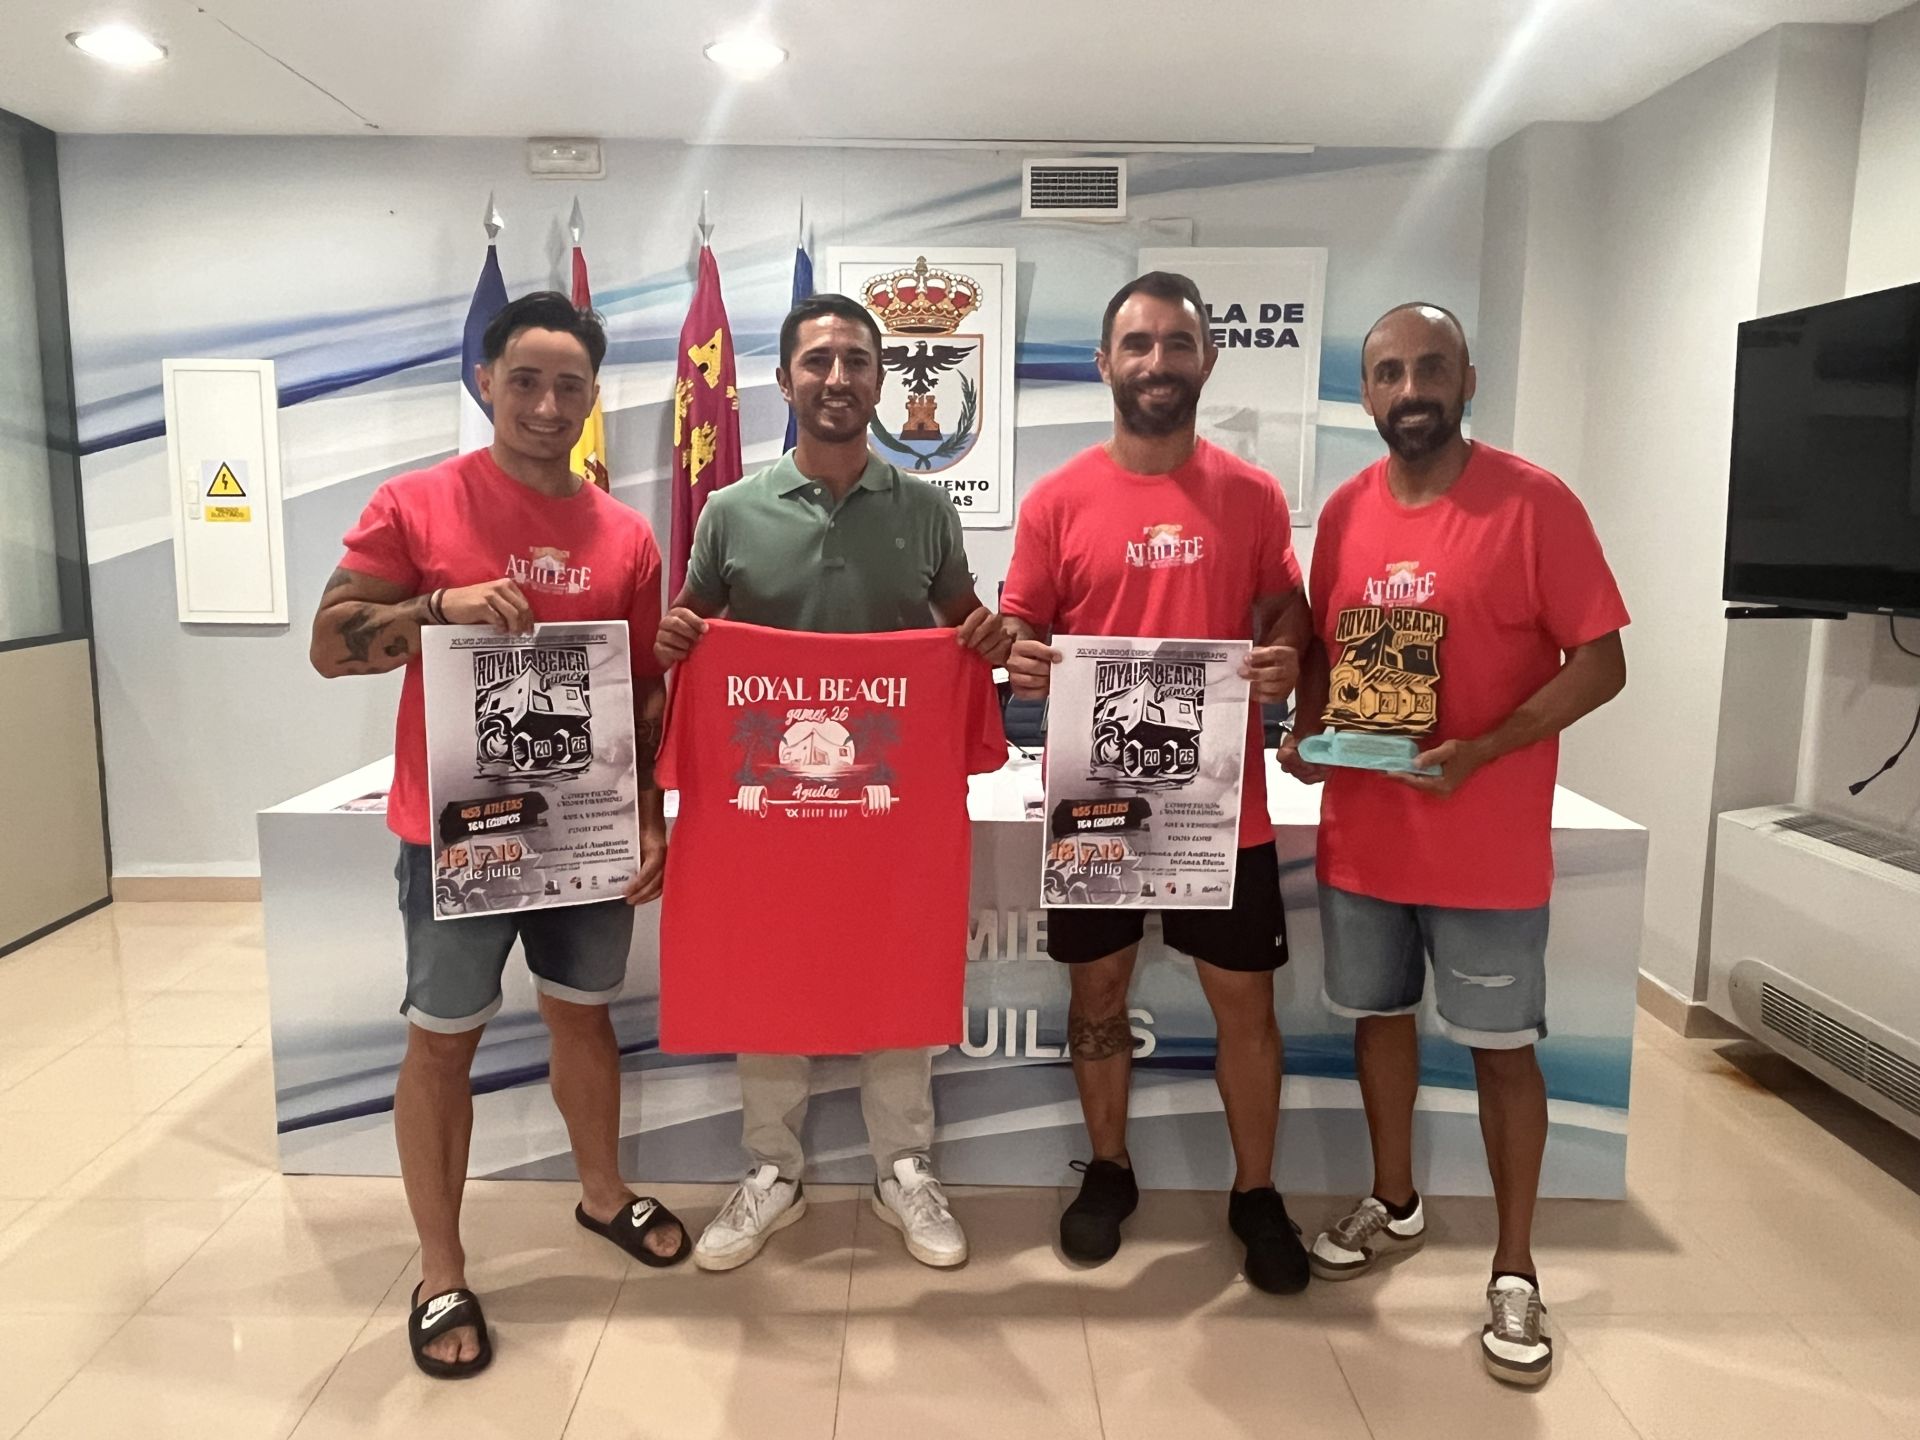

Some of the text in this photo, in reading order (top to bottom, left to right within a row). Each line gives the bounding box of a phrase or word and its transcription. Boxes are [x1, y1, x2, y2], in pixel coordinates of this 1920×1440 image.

[1259, 303, 1304, 323] DE
[1393, 608, 1442, 636] BEACH
[477, 649, 586, 687] ROYAL BEACH
[1097, 660, 1202, 694] ROYAL BEACH
[727, 675, 907, 707] ROYAL BEACH
[831, 706, 850, 721] 26
[535, 741, 551, 757] 20
[572, 737, 587, 752] 26
[1144, 750, 1159, 766] 20
[1180, 750, 1194, 764] 26
[463, 867, 484, 880] de
[486, 863, 521, 881] julio
[1069, 863, 1122, 878] de julio
